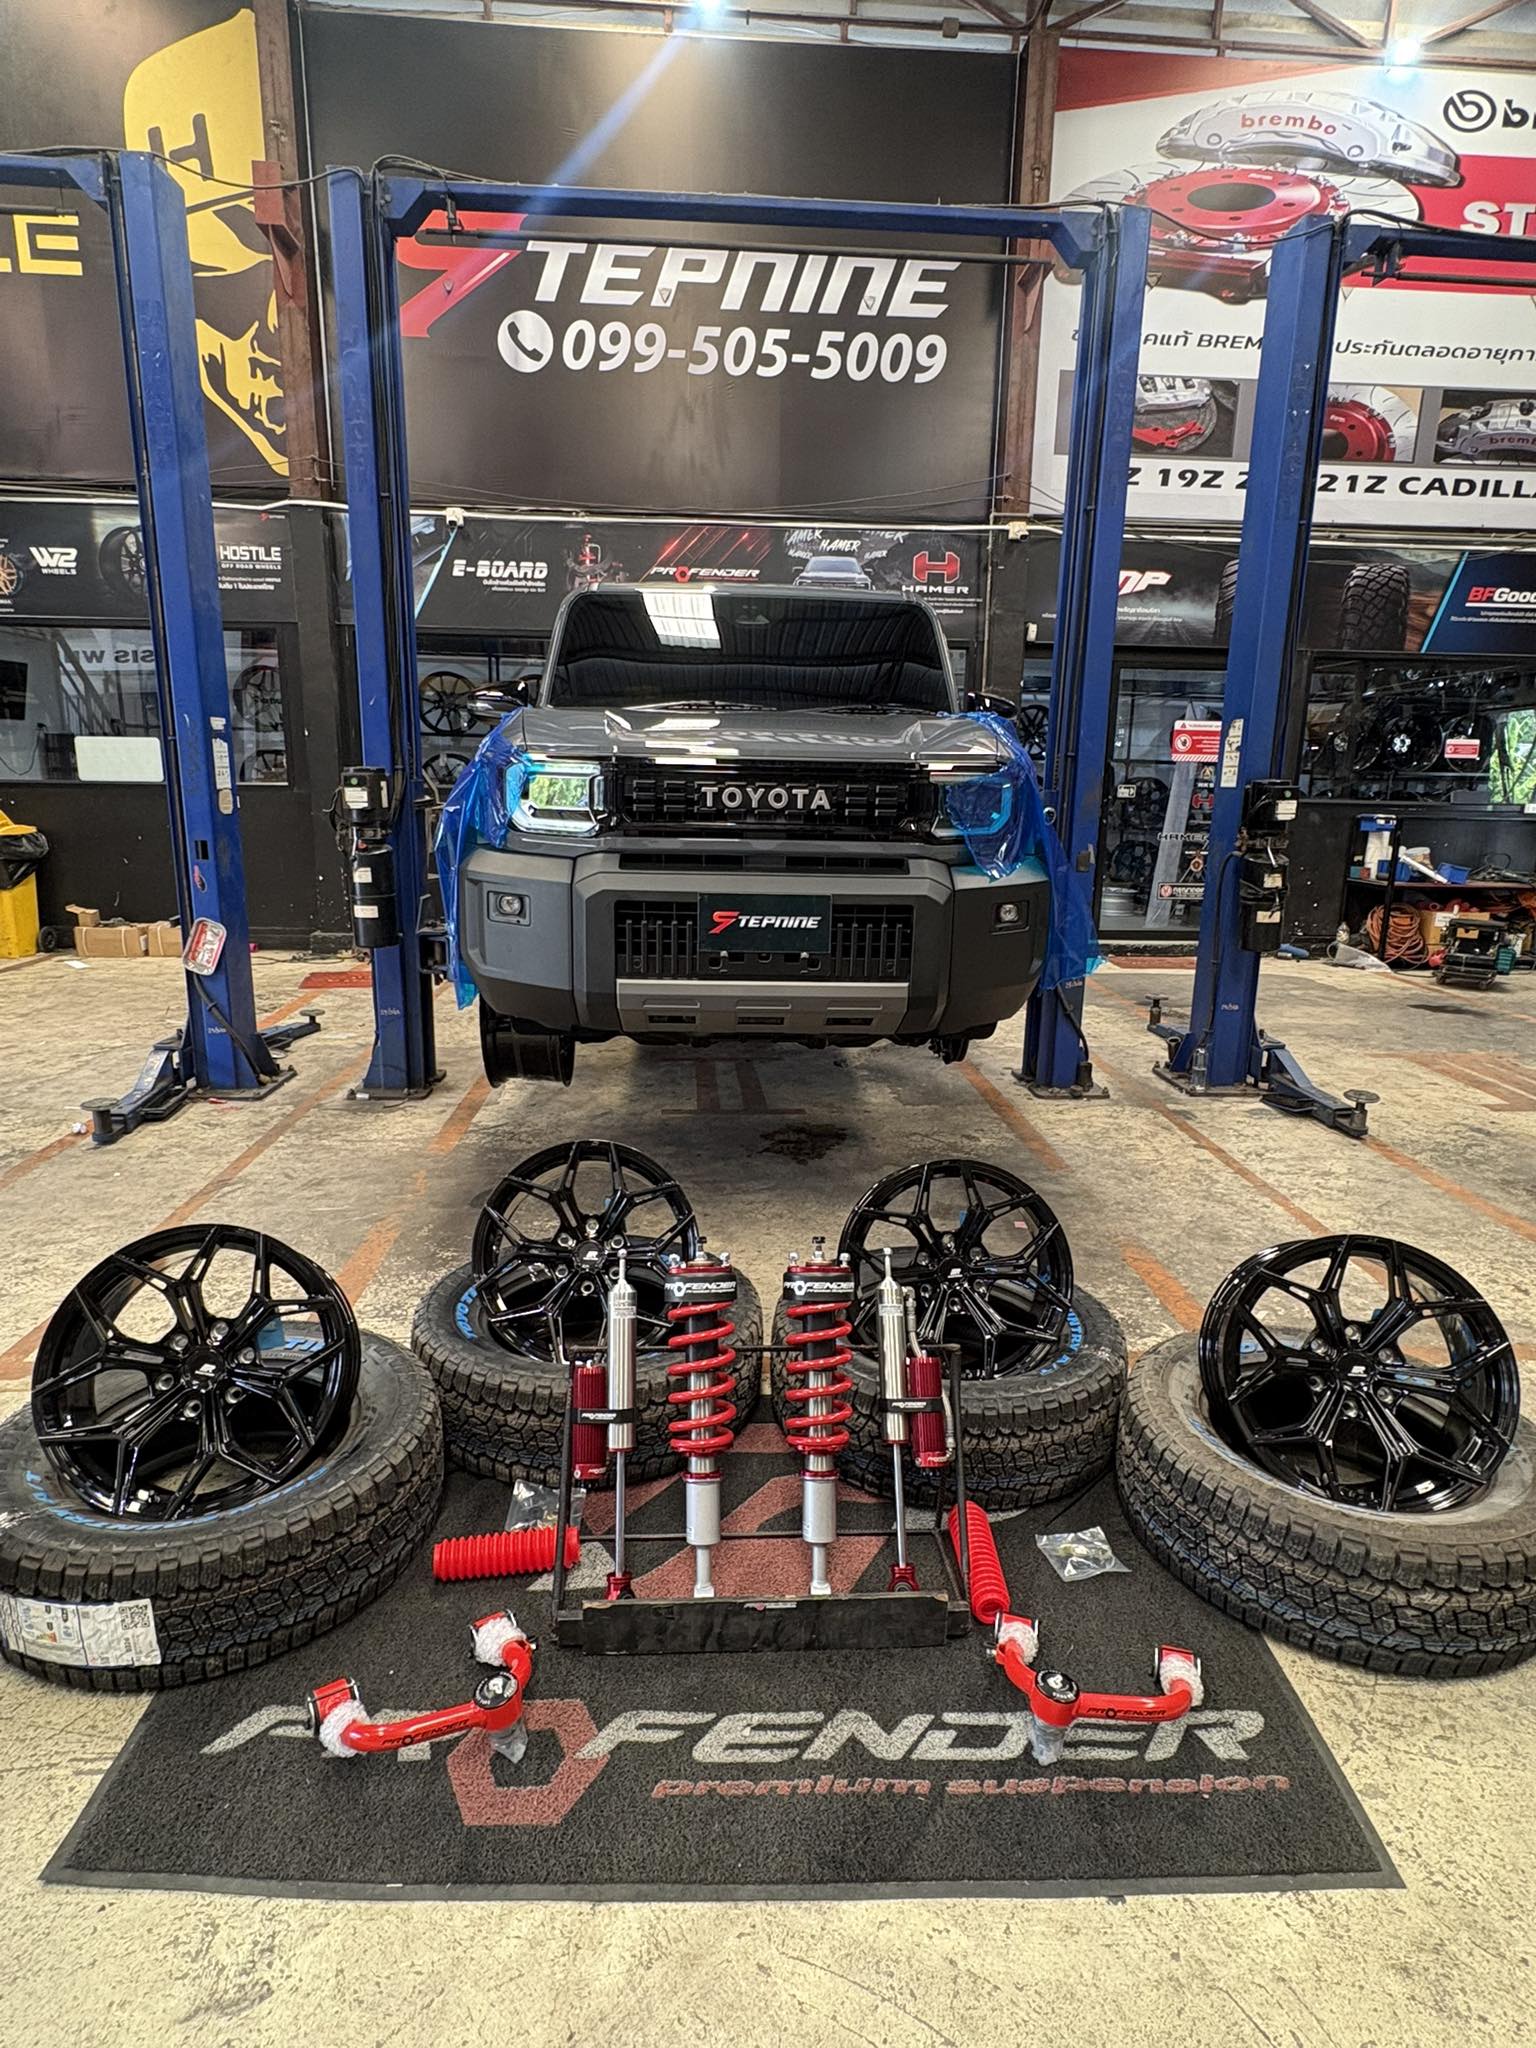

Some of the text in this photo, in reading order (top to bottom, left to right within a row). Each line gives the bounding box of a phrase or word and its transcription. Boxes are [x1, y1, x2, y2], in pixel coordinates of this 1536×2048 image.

[1241, 113, 1337, 136] brembo
[562, 318, 948, 383] 099-505-5009
[1158, 468, 1225, 489] 19Z
[1318, 474, 1388, 494] 21Z
[1398, 476, 1536, 499] CADILL
[219, 545, 282, 561] HOSTILE
[819, 538, 862, 553] HAMER
[452, 559, 548, 579] E-BOARD
[901, 584, 969, 595] HAMER
[701, 786, 831, 810] TOYOTA
